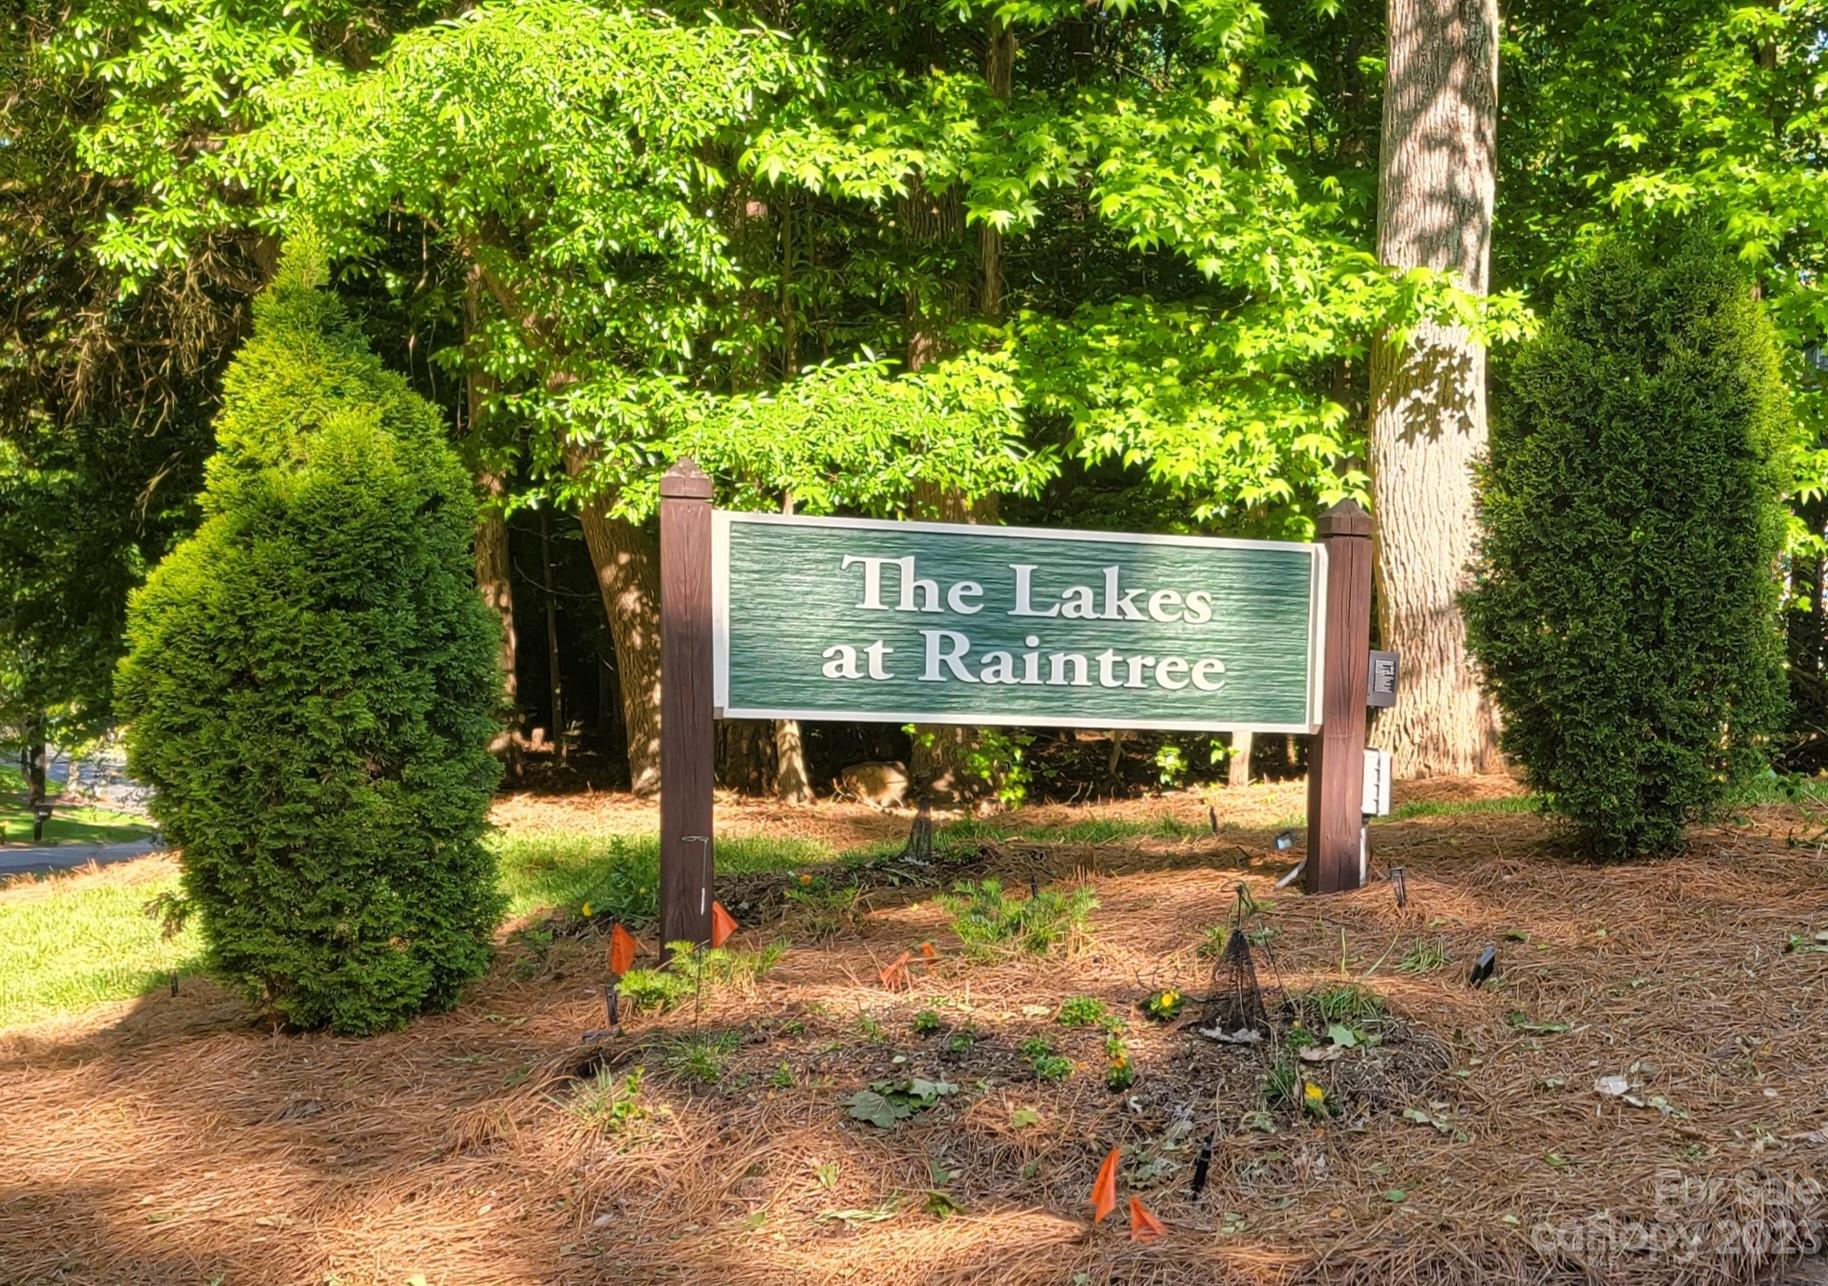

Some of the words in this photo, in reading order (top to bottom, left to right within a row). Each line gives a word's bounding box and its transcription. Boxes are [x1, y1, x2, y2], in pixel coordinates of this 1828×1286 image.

[841, 554, 985, 615] The
[1007, 563, 1213, 624] Lakes
[822, 640, 895, 680] at
[917, 630, 1226, 691] Raintree
